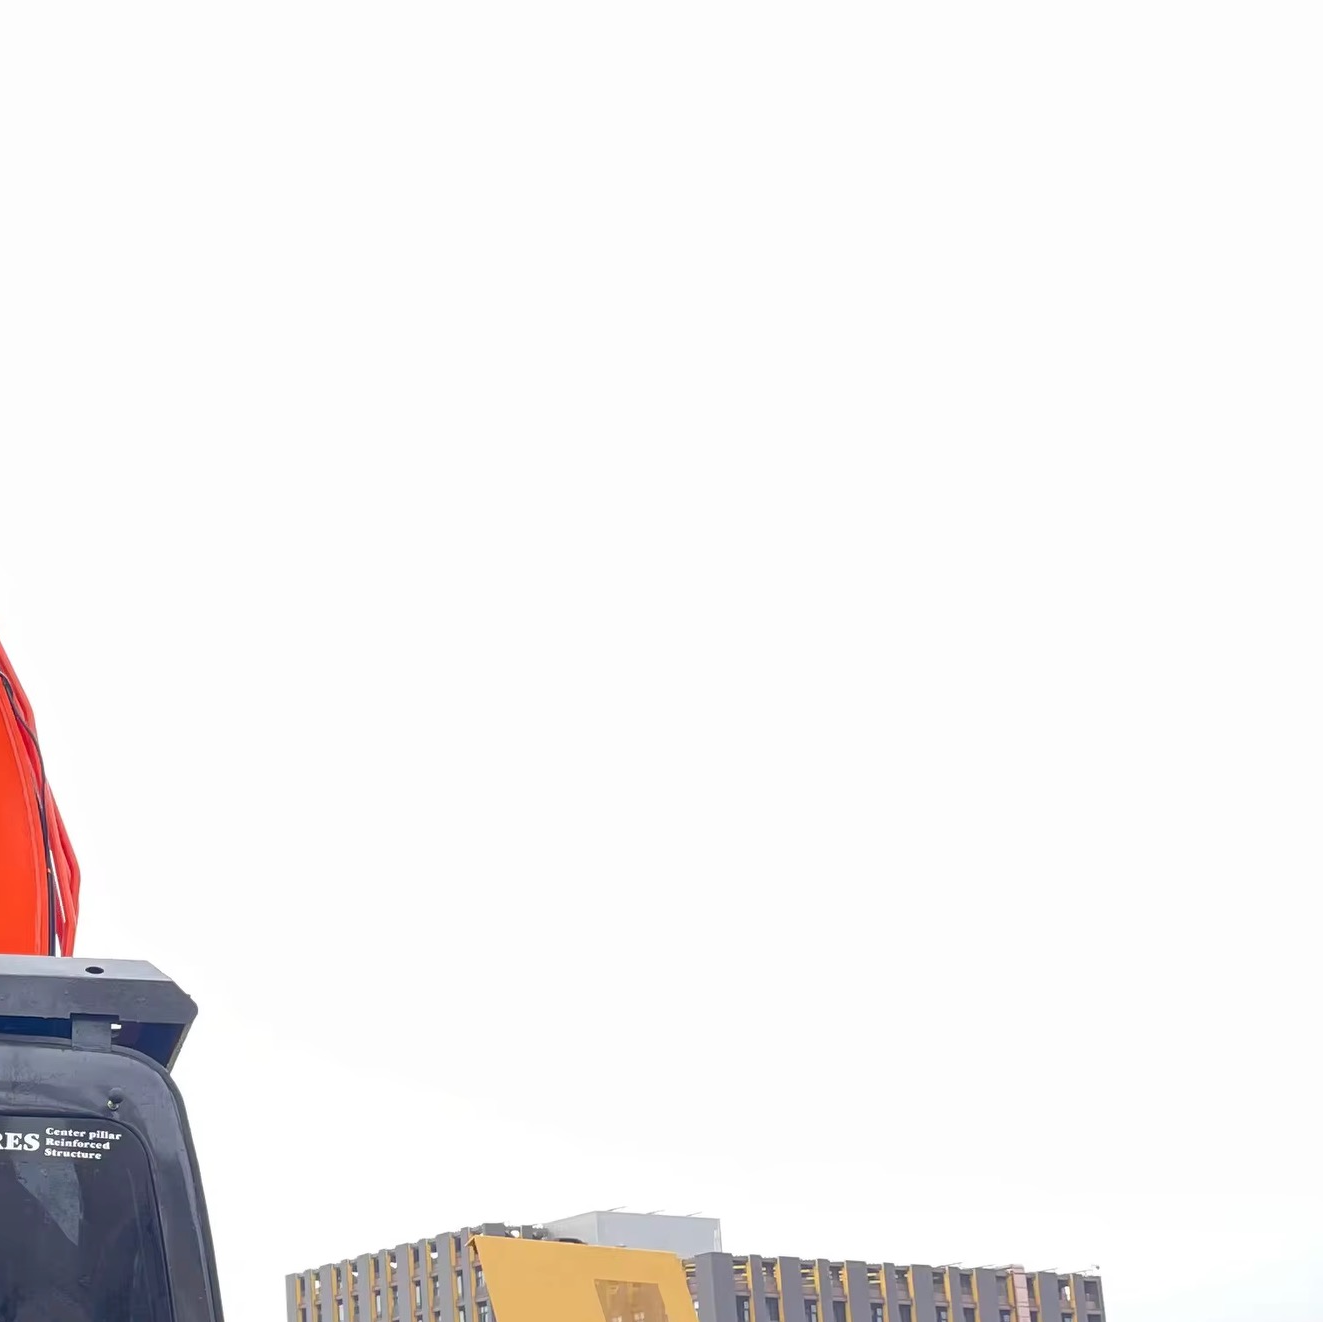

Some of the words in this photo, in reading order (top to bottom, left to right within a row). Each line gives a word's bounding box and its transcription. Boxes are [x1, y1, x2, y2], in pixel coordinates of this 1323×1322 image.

[45, 1127, 86, 1138] Center
[88, 1130, 122, 1140] pillar
[45, 1138, 111, 1150] Reinforced
[44, 1147, 102, 1160] Structure
